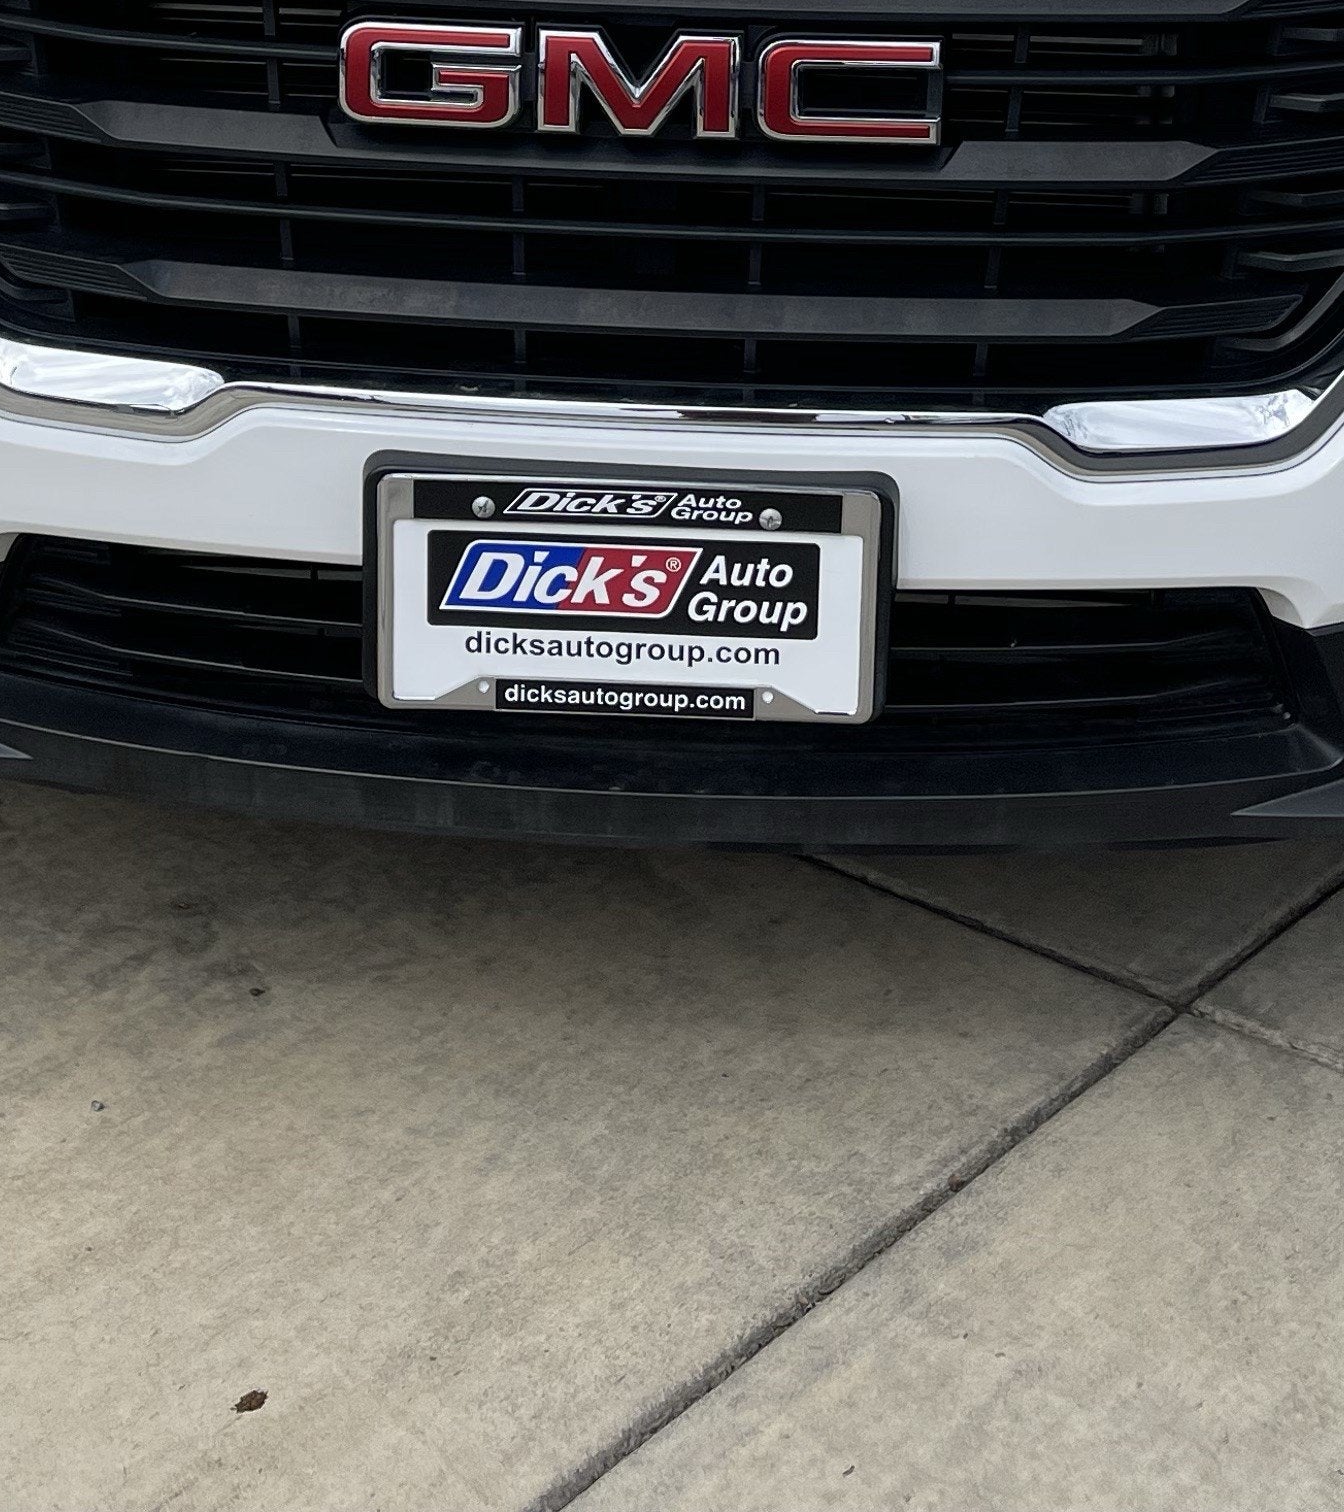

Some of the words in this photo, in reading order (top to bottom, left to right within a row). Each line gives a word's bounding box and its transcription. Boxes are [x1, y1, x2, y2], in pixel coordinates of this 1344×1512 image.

[339, 21, 941, 144] GMC
[670, 507, 753, 524] Group
[677, 494, 742, 509] Auto
[700, 555, 793, 589] Auto
[686, 591, 808, 632] Group
[464, 631, 780, 667] dicksautogroup.com
[504, 682, 746, 711] dicksautogroup.com
